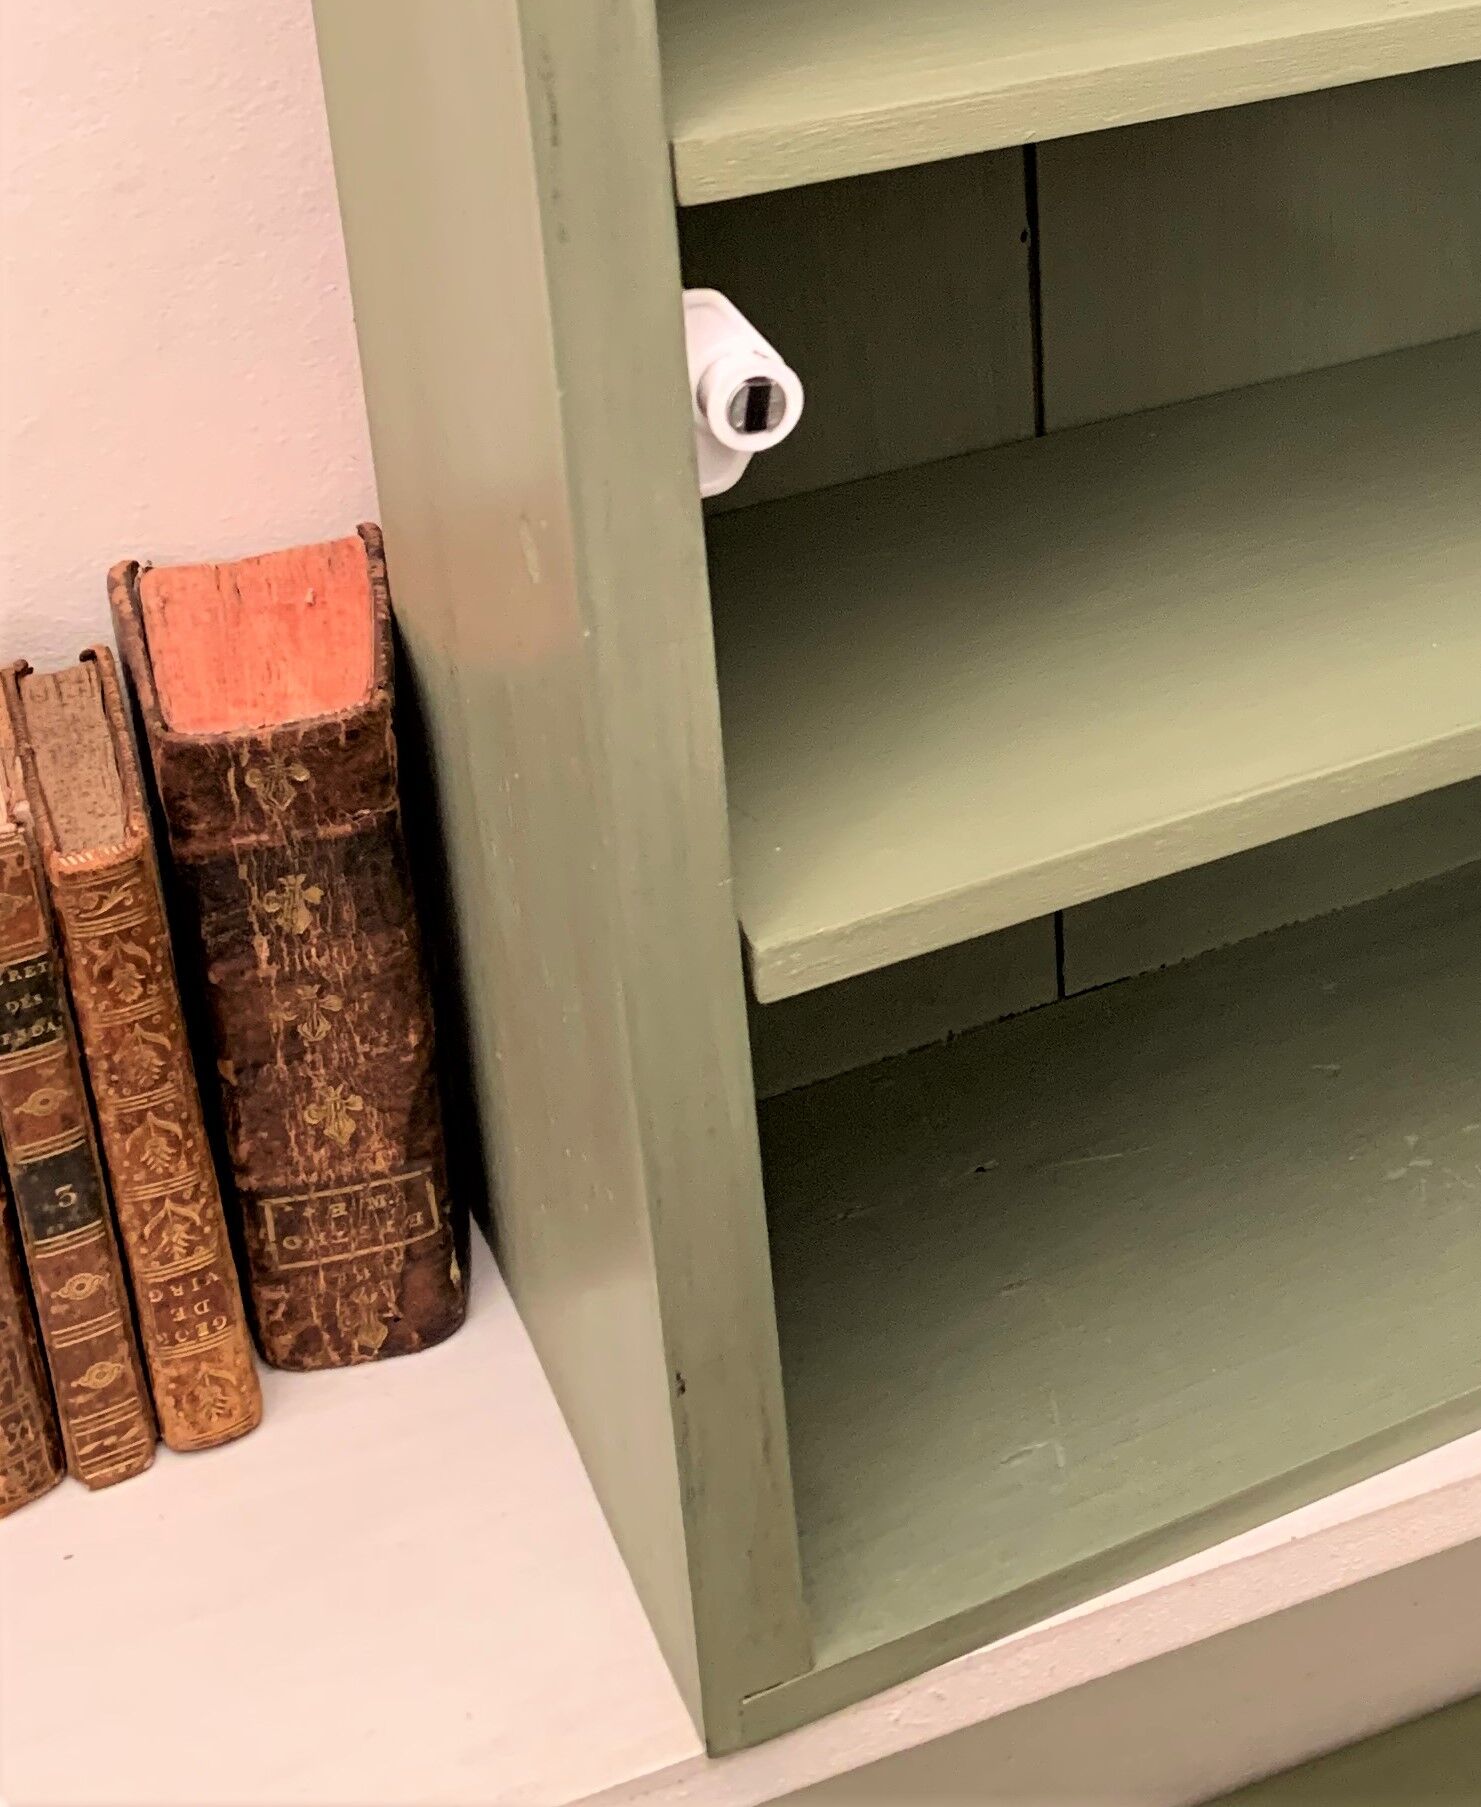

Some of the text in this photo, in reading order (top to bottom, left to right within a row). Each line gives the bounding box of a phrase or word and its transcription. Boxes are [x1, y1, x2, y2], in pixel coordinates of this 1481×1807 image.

[0, 961, 48, 986] RET
[148, 1272, 220, 1303] VIRG
[170, 1299, 211, 1322] DE
